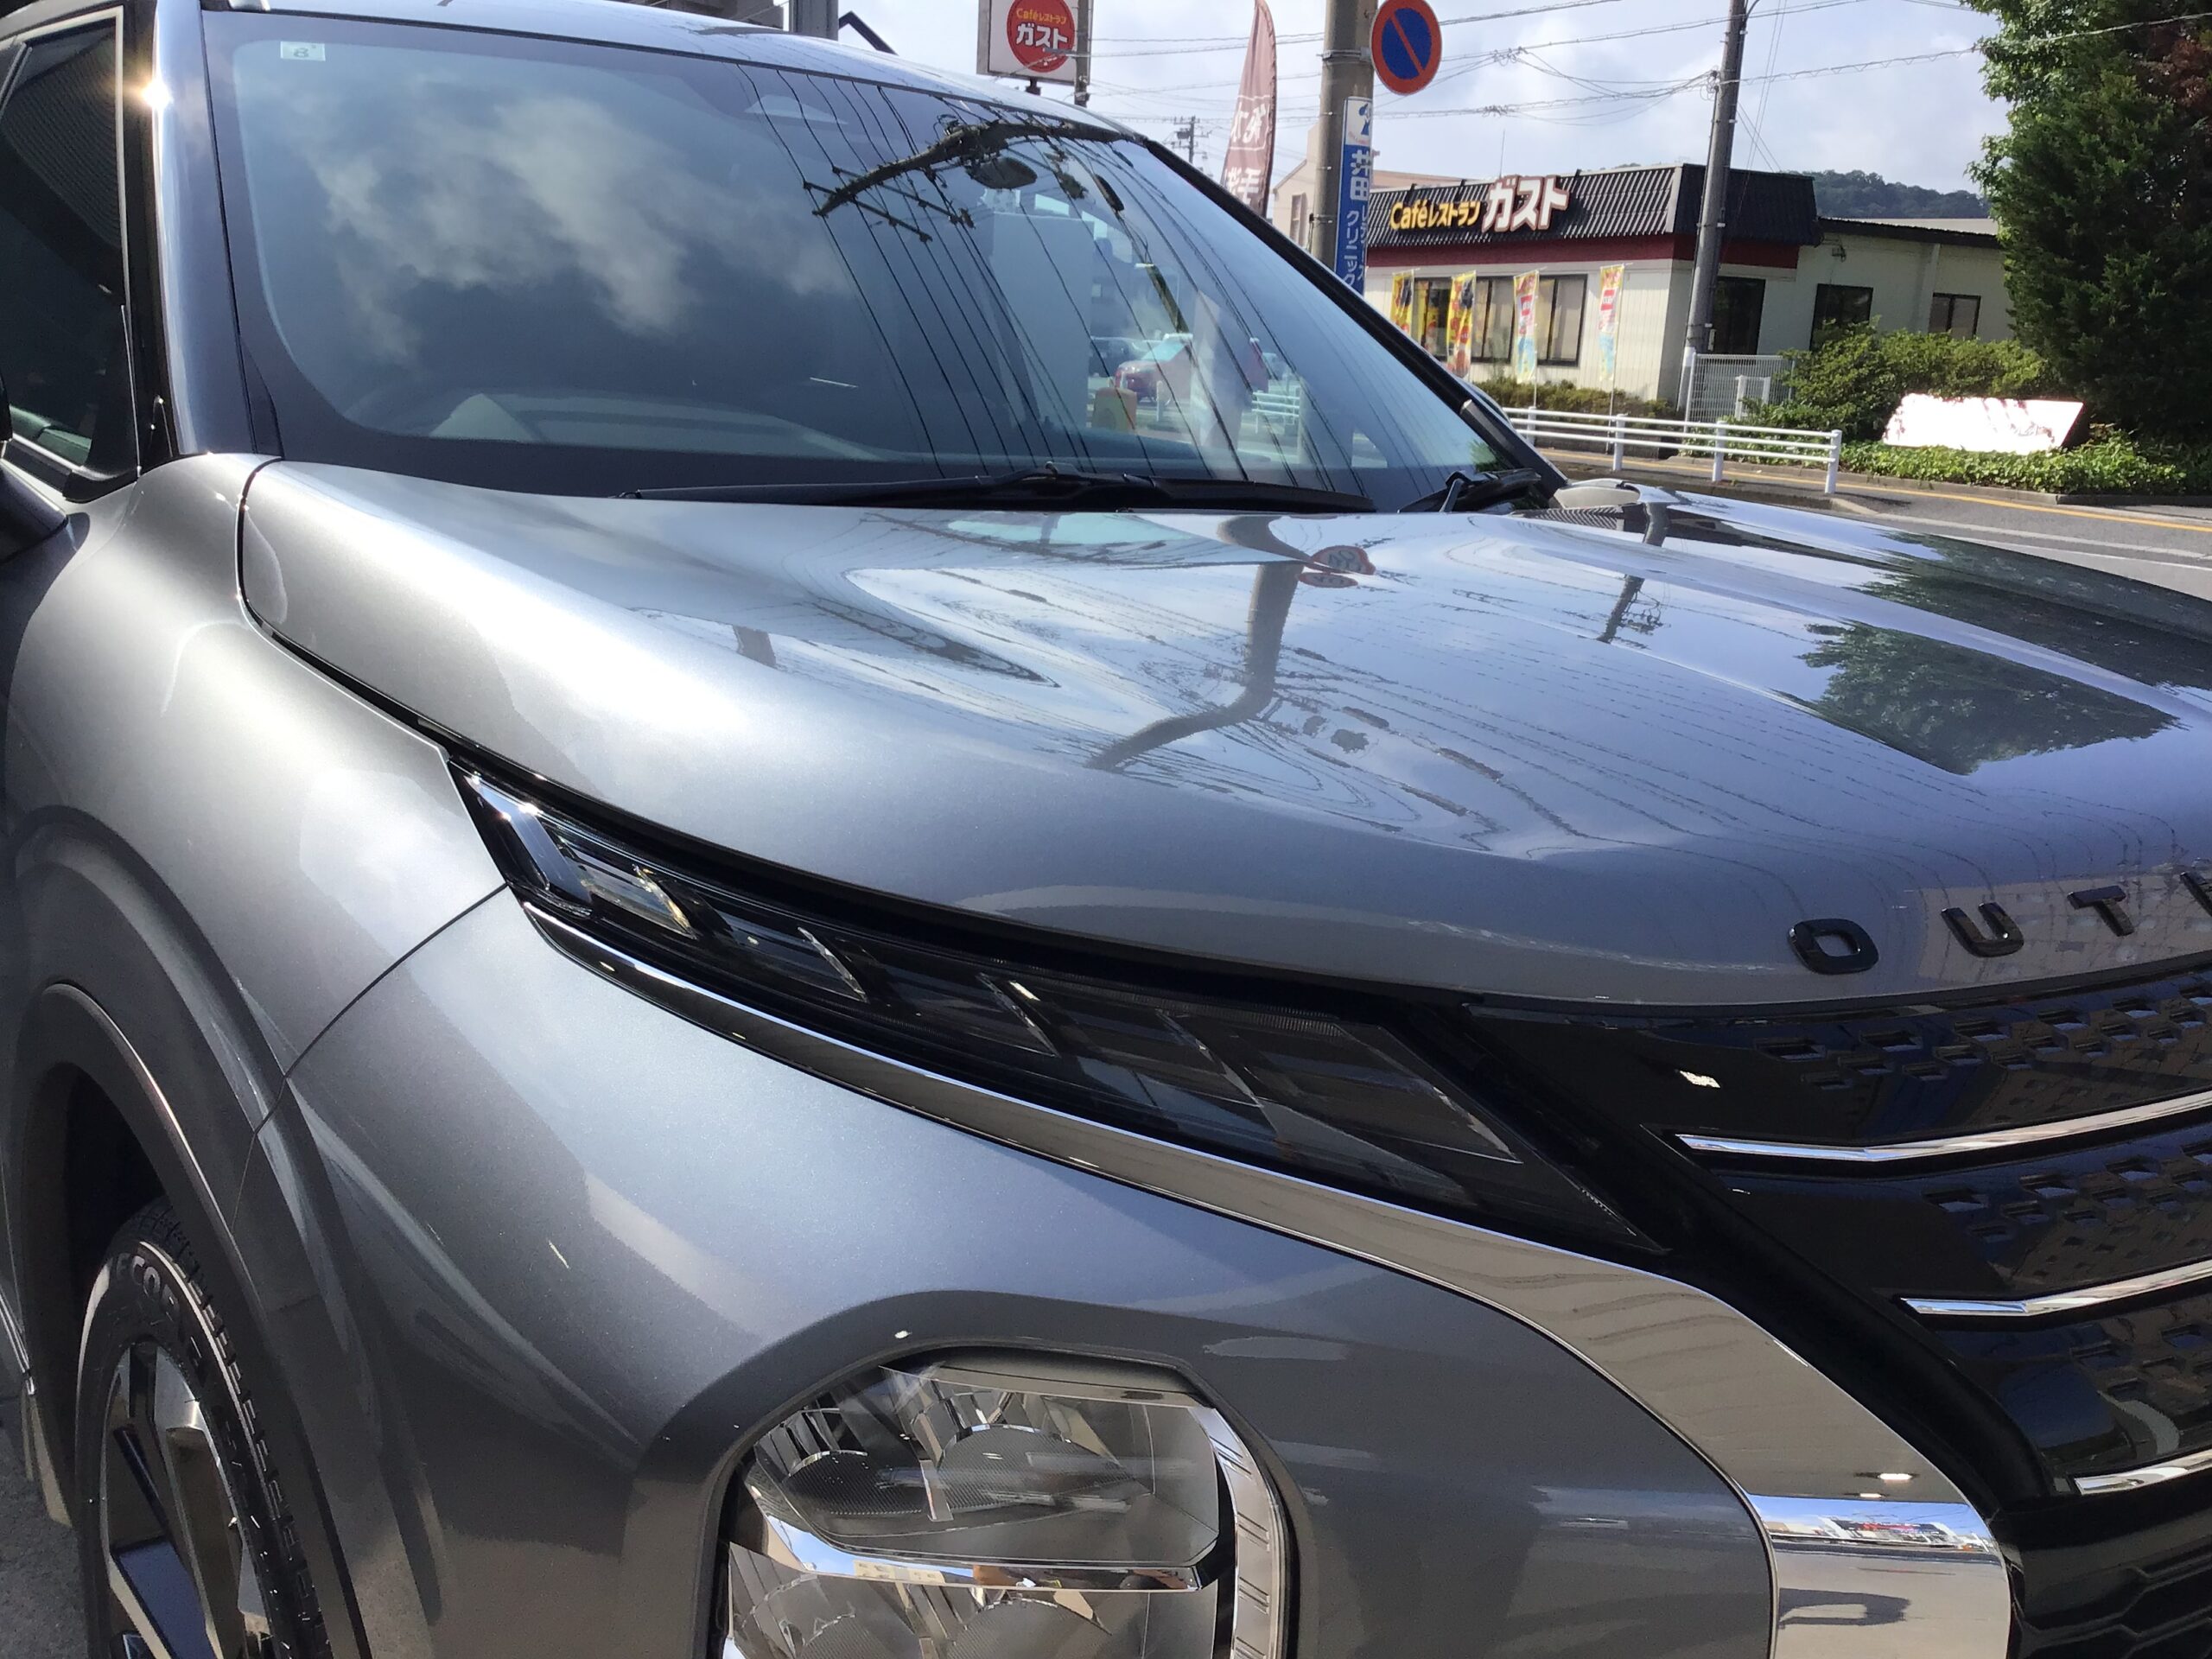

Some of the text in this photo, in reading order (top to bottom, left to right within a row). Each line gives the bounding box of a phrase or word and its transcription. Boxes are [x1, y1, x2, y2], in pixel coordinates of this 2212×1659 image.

[1016, 8, 1067, 24] Caféレストラン
[1016, 22, 1068, 49] ガスト
[1390, 175, 1569, 232] Caféレストラン ガスト
